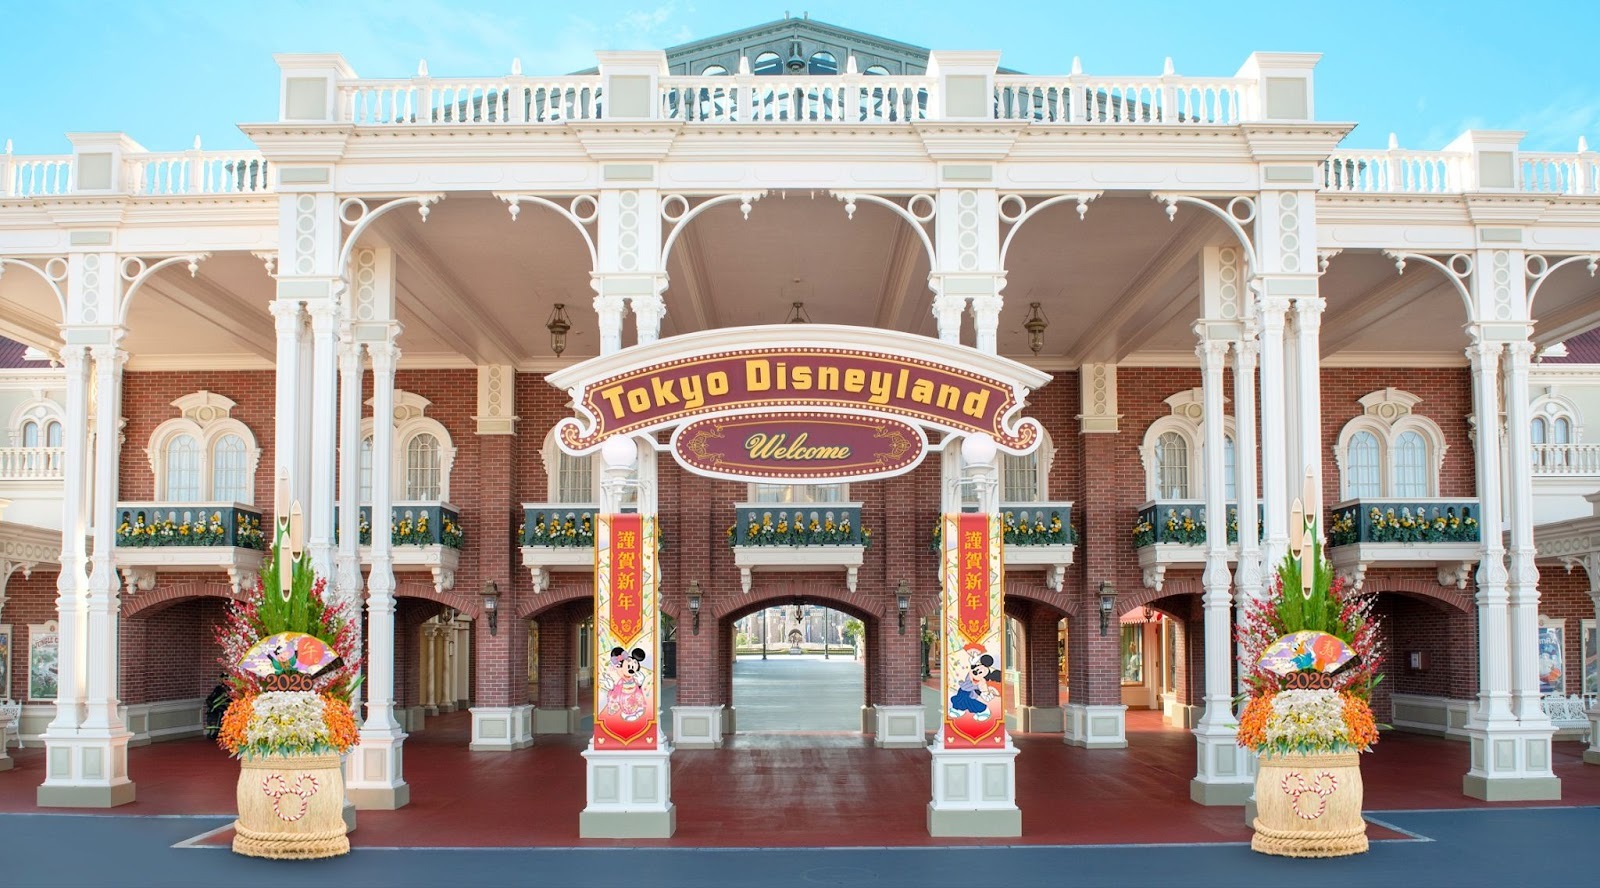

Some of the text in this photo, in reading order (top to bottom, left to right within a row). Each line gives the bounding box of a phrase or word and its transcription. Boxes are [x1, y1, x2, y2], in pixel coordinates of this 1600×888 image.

[602, 359, 990, 419] Tokyo Disneyland
[745, 432, 851, 459] Welcome
[617, 531, 635, 611] 謹賀新年
[964, 531, 983, 611] 謹賀新年
[302, 641, 316, 660] 午
[266, 674, 313, 691] 2026
[1285, 672, 1332, 689] 2026
